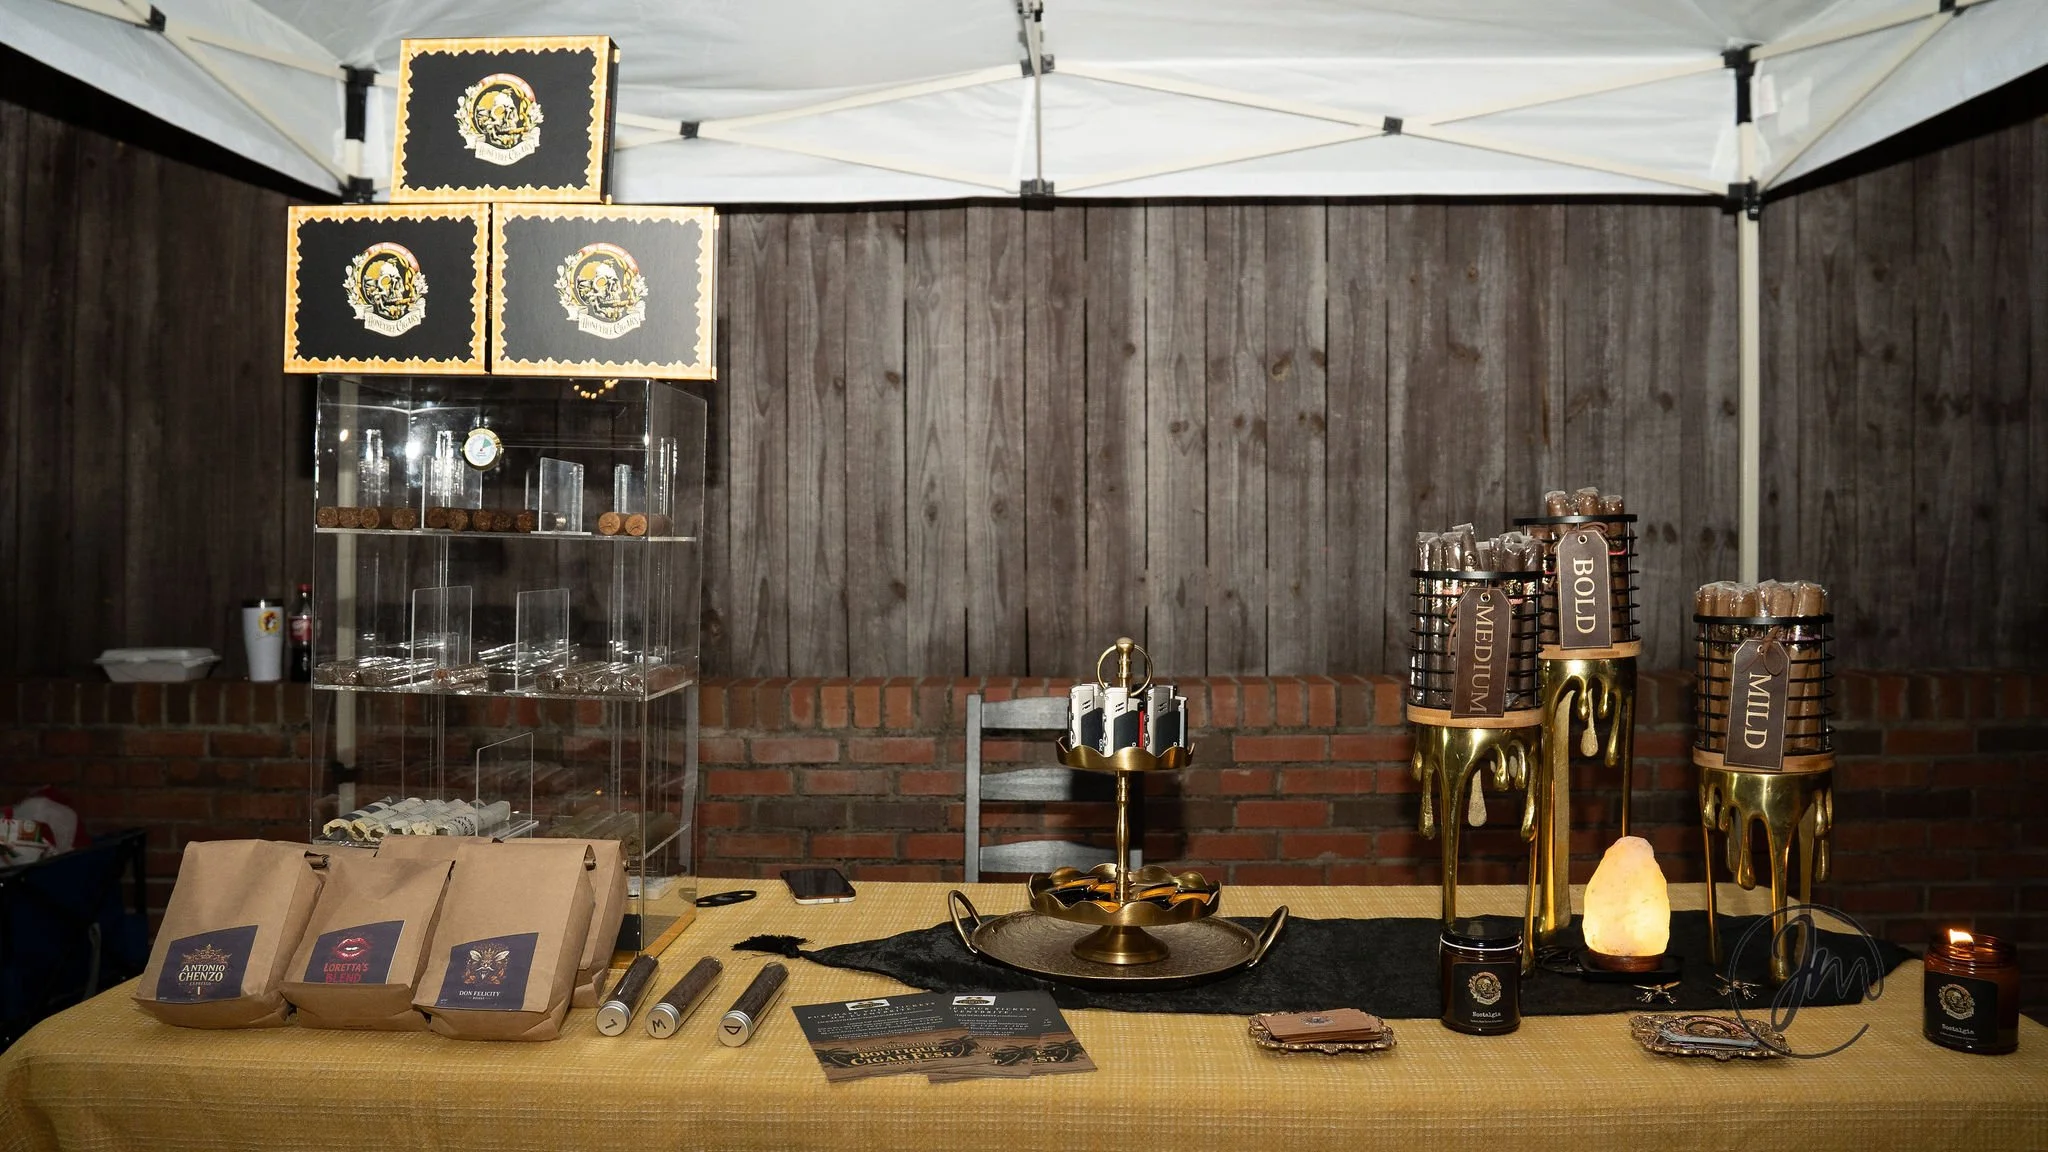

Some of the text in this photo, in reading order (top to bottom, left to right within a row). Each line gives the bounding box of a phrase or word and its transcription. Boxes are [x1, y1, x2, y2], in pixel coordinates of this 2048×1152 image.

[1573, 557, 1597, 635] BOLD
[1469, 603, 1495, 713] MEDIUM
[1744, 672, 1772, 750] MILD
[182, 964, 226, 972] ANTONIO
[323, 962, 369, 972] LORETTA'S
[178, 971, 223, 982] CHENZO
[325, 973, 362, 984] BLEND
[1472, 1011, 1502, 1019] Nostalgia
[724, 1025, 742, 1035] D
[859, 1046, 942, 1058] BOUTIQUE
[850, 1054, 910, 1066] CIGAR
[911, 1051, 954, 1060] FEST
